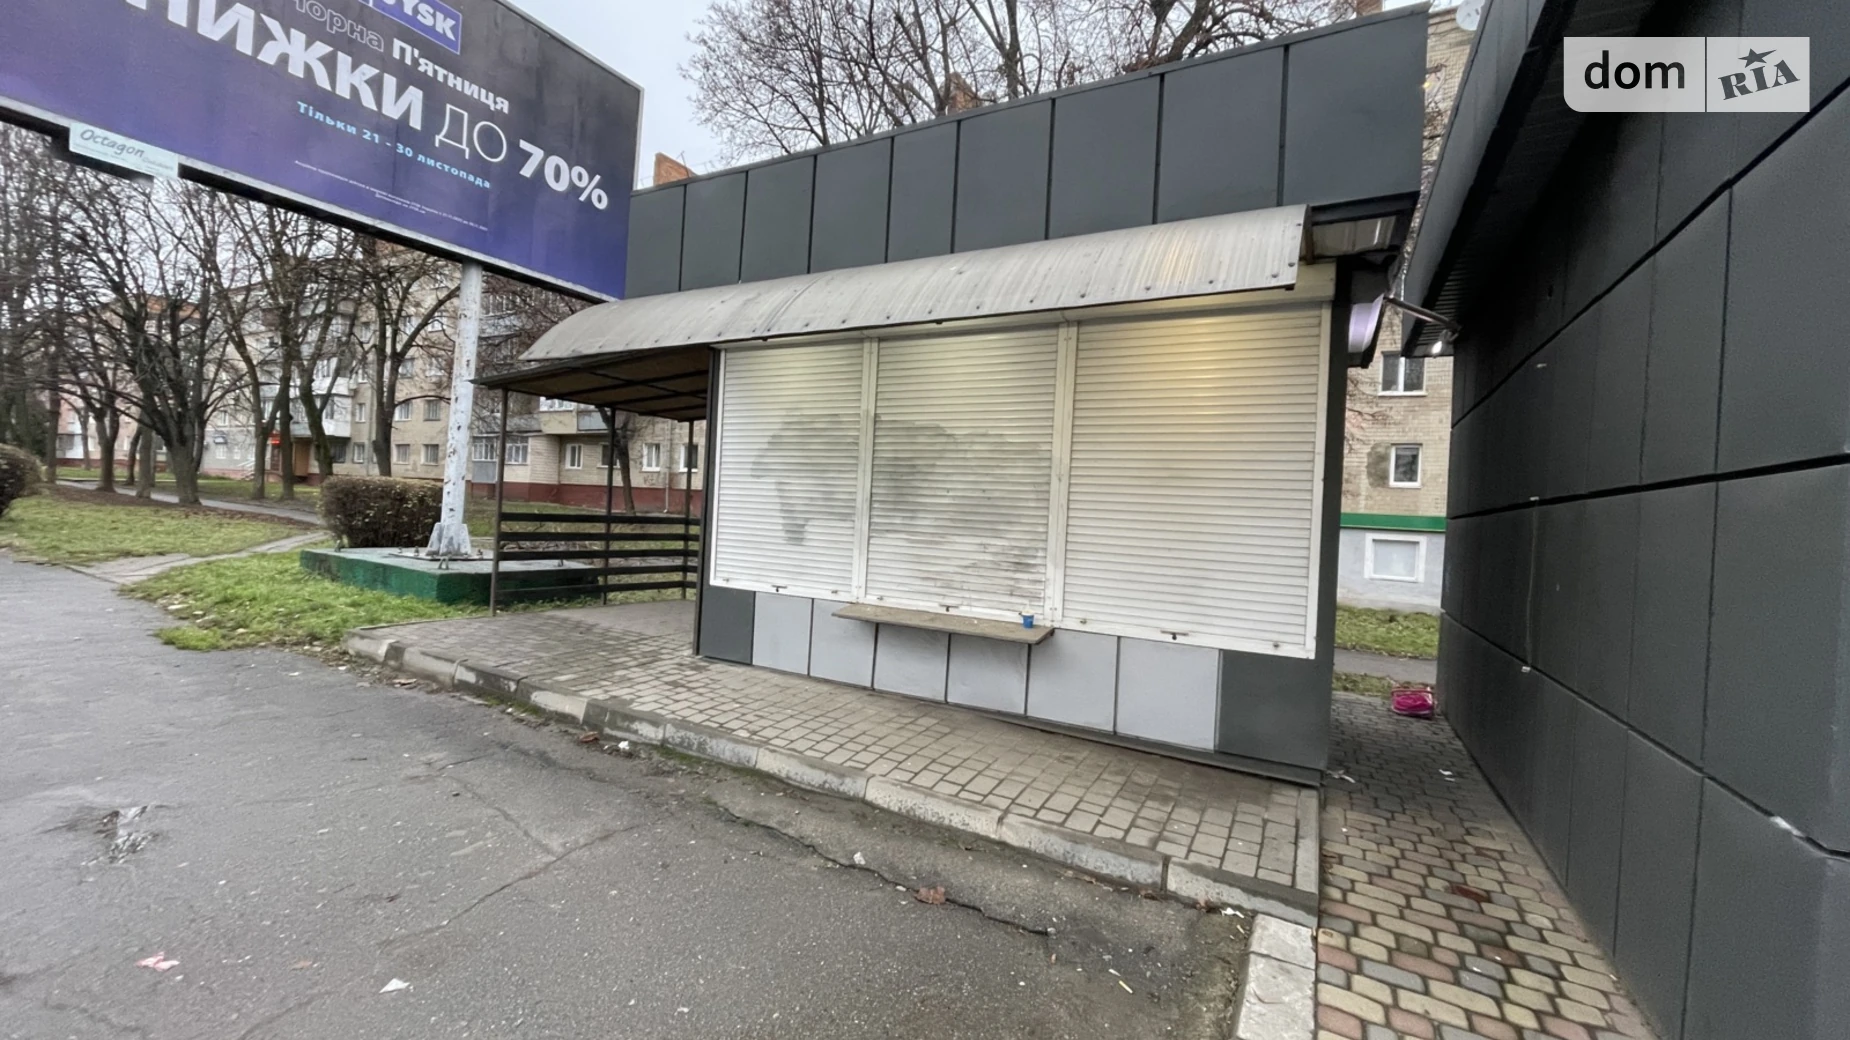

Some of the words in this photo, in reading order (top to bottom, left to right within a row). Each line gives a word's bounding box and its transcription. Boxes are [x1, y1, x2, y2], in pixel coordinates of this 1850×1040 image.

[383, 0, 455, 41] YSK
[392, 38, 509, 114] П'ятниця
[80, 129, 145, 157] Octagon
[297, 101, 357, 135] Тільки
[362, 129, 379, 144] 21
[396, 142, 413, 157] 30
[417, 153, 490, 189] листопада
[435, 103, 507, 162] ДО
[519, 139, 608, 210] 70%
